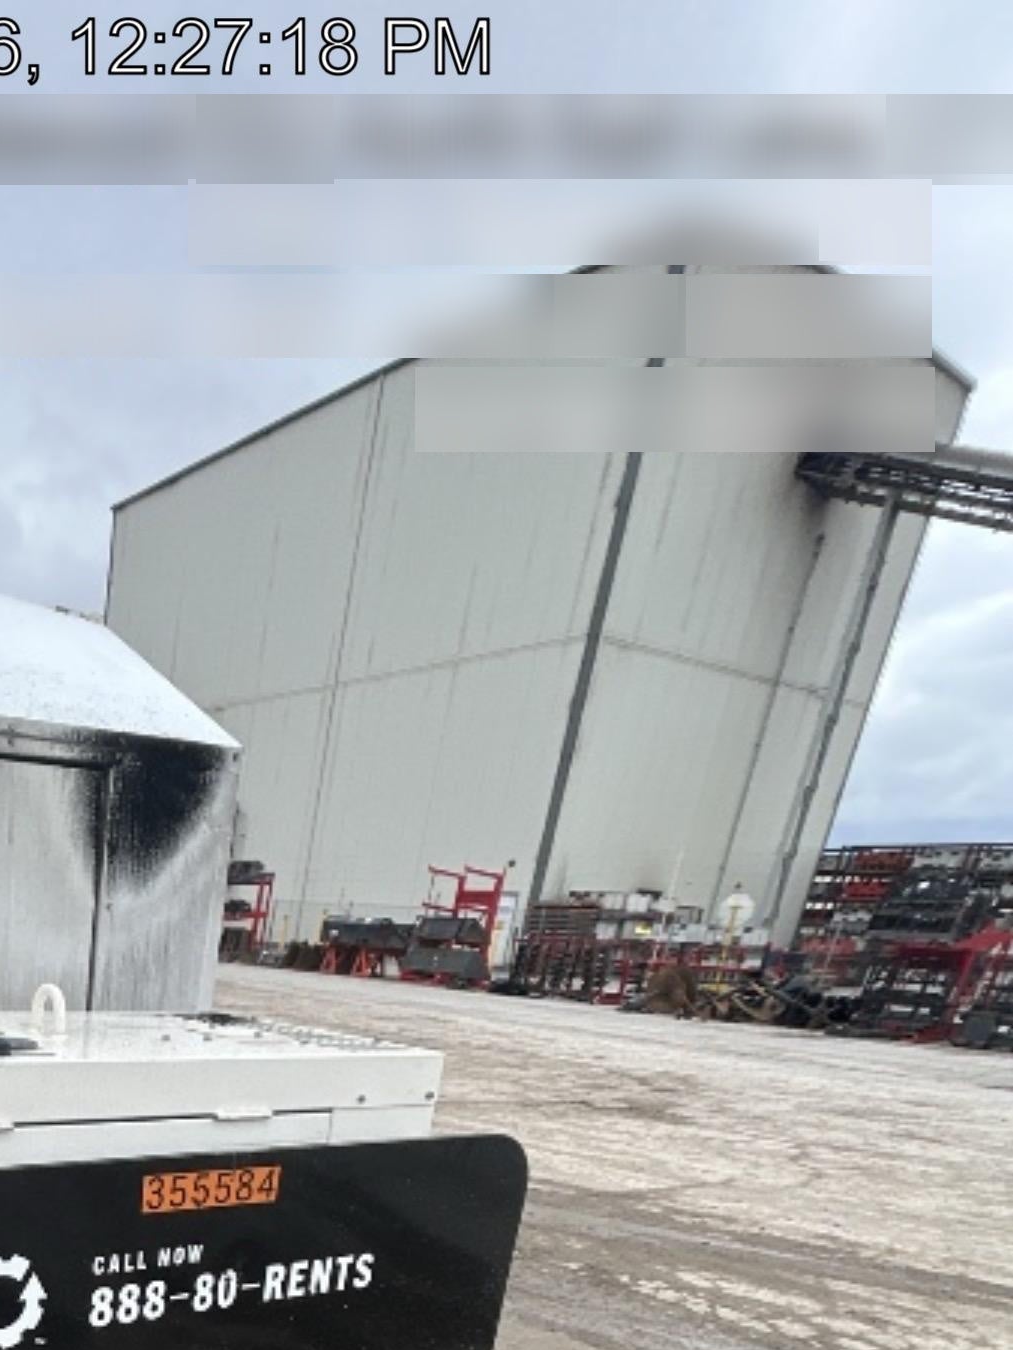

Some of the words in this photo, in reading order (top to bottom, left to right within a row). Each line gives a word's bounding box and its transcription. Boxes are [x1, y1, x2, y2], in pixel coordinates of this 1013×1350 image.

[146, 1169, 277, 1210] 355584
[92, 1252, 147, 1276] CALL
[157, 1244, 205, 1268] NOW
[88, 1252, 376, 1328] 888-80-RENTS
